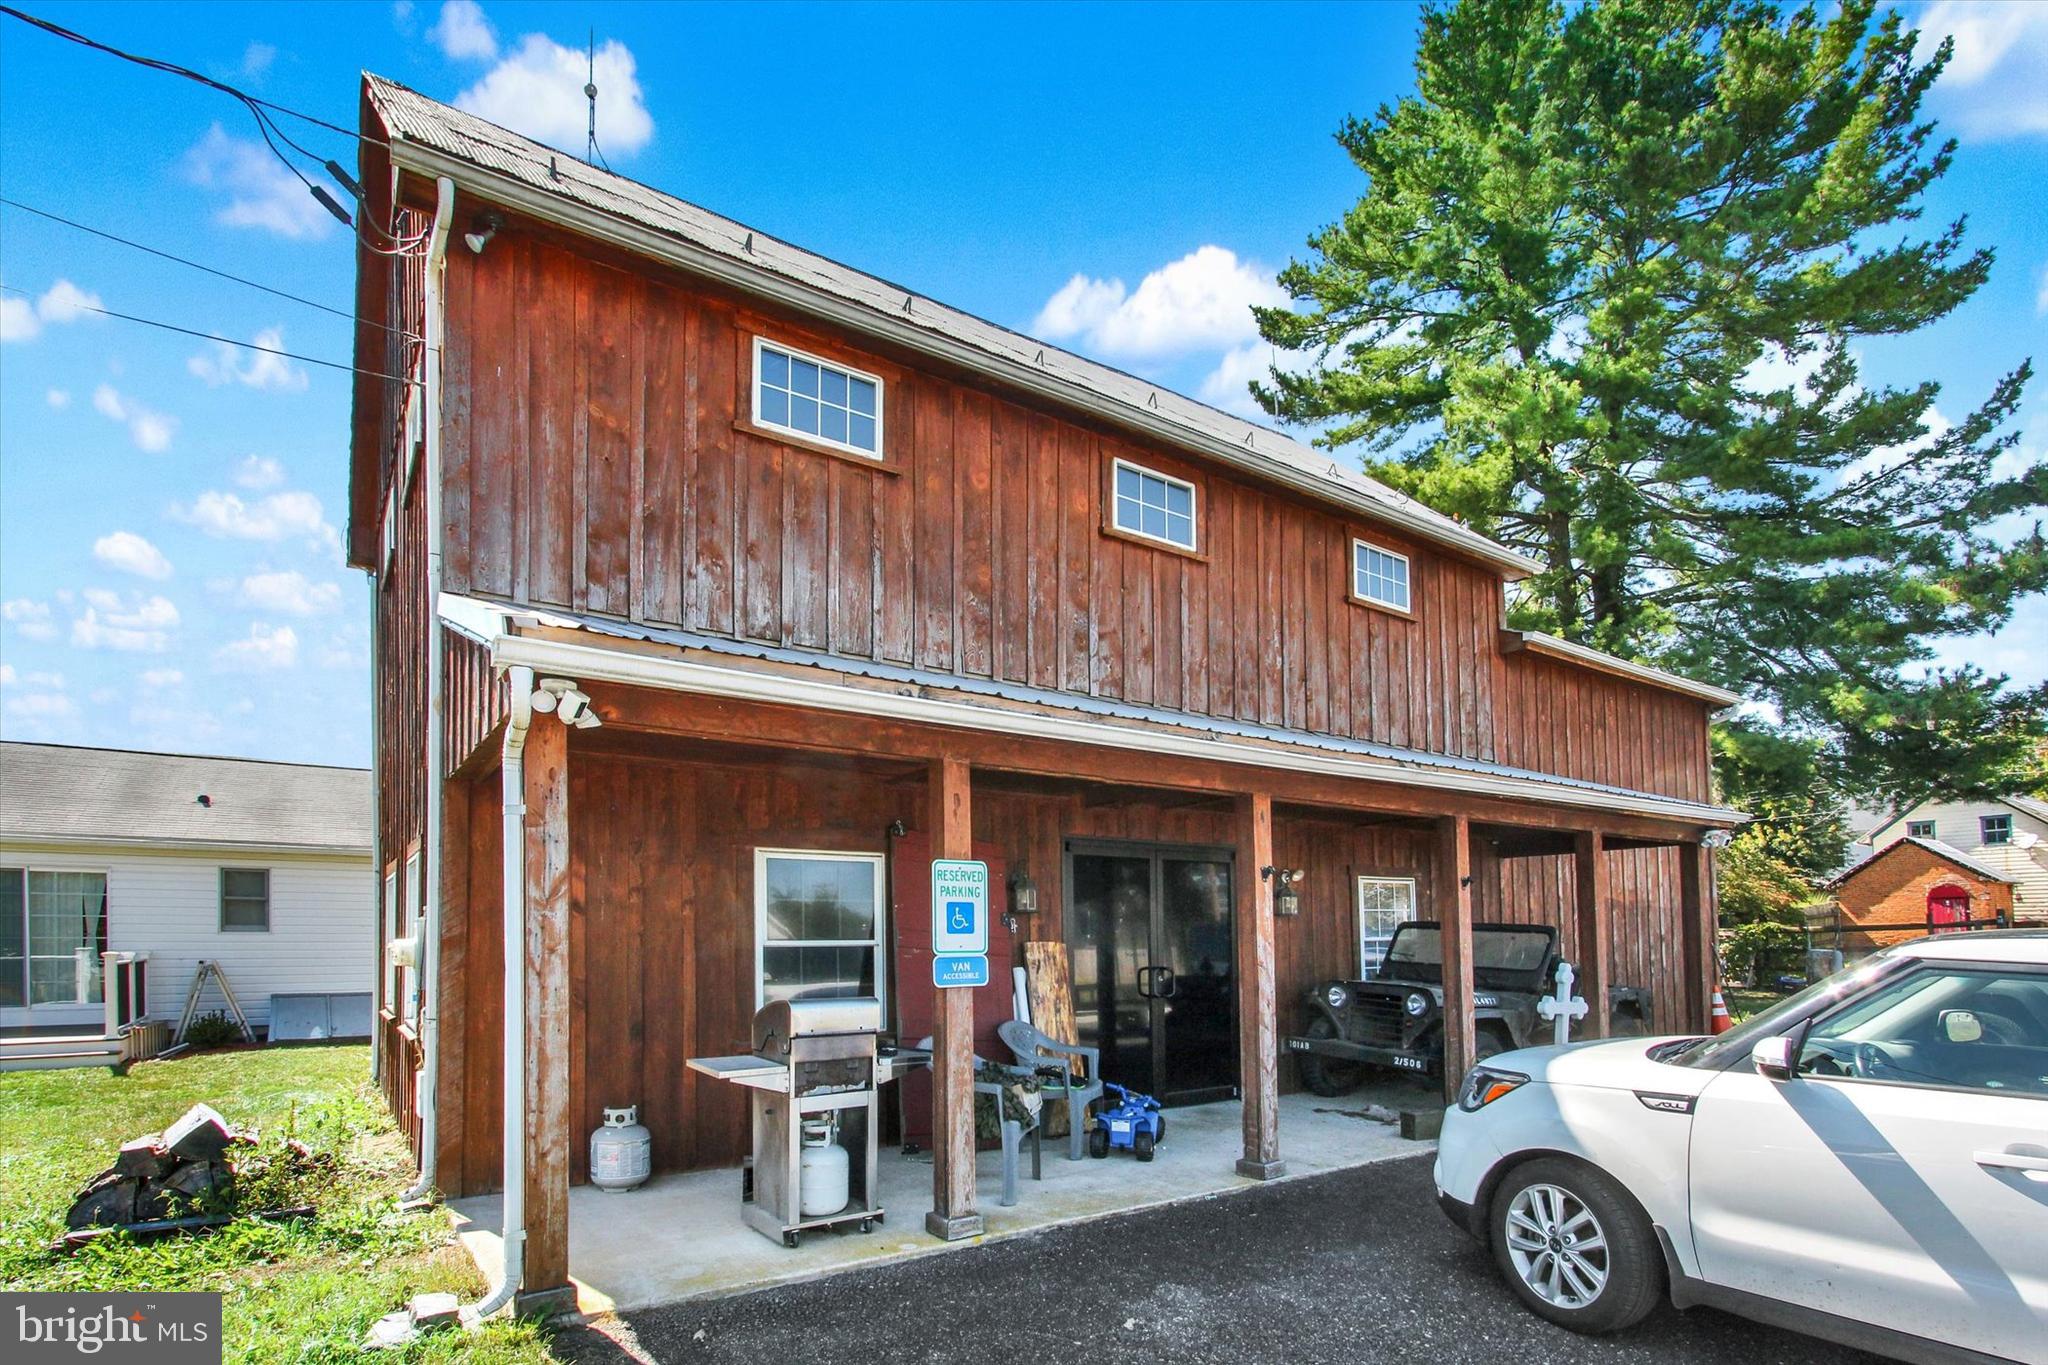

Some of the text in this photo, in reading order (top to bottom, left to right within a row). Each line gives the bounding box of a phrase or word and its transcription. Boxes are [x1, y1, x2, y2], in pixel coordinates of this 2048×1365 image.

[937, 869, 984, 882] RESERVED
[940, 885, 981, 898] PARKING
[951, 961, 971, 972] VAN
[942, 972, 980, 980] ACCESSIBLE
[1393, 1056, 1422, 1069] 2/506
